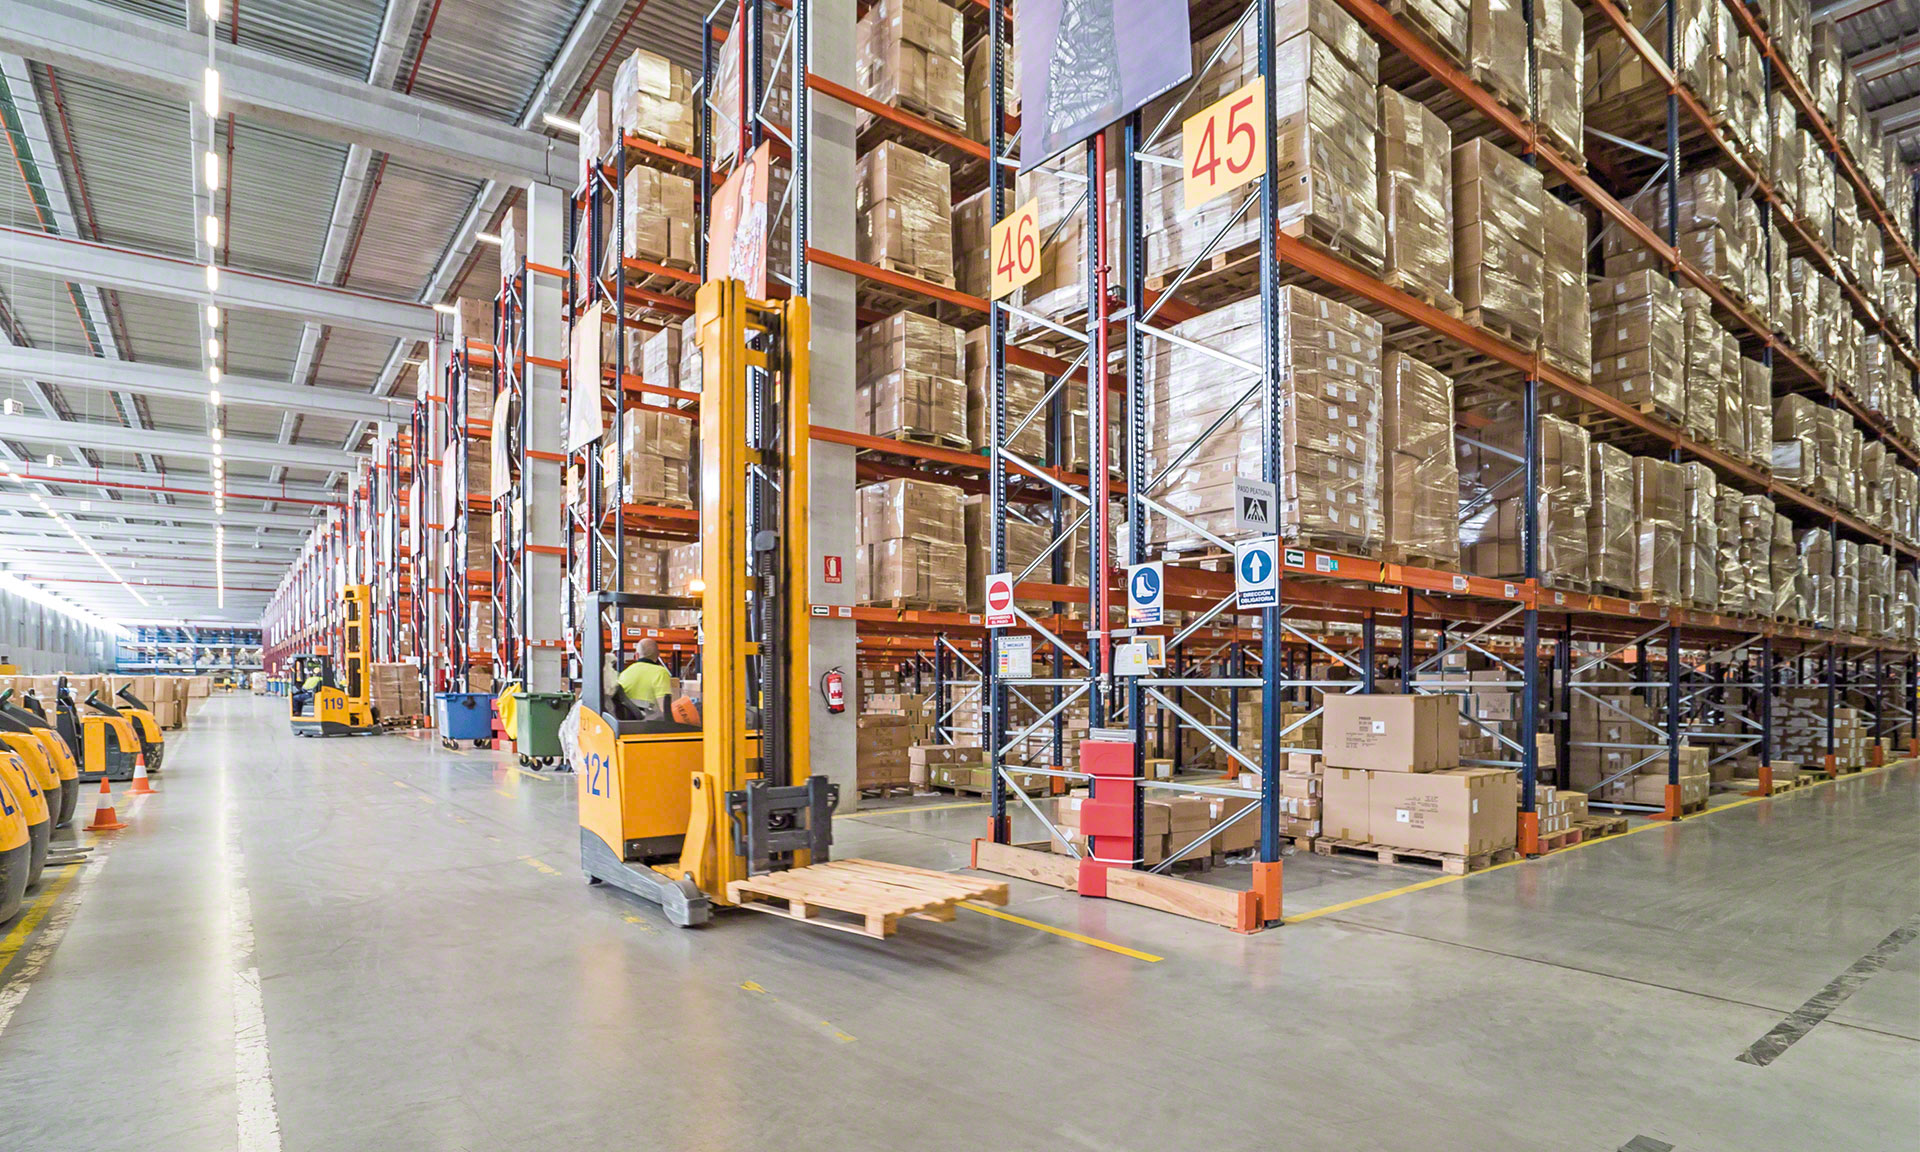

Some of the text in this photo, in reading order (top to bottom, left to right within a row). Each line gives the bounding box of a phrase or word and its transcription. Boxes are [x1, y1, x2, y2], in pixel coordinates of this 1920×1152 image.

[1192, 95, 1256, 186] 45
[997, 214, 1035, 282] 46
[1237, 484, 1272, 497] PASO PEATONAL
[1240, 596, 1274, 604] OBLIGATORIA
[1242, 590, 1271, 598] DIRECCIÓN
[323, 697, 344, 710] 119
[583, 752, 609, 798] 121
